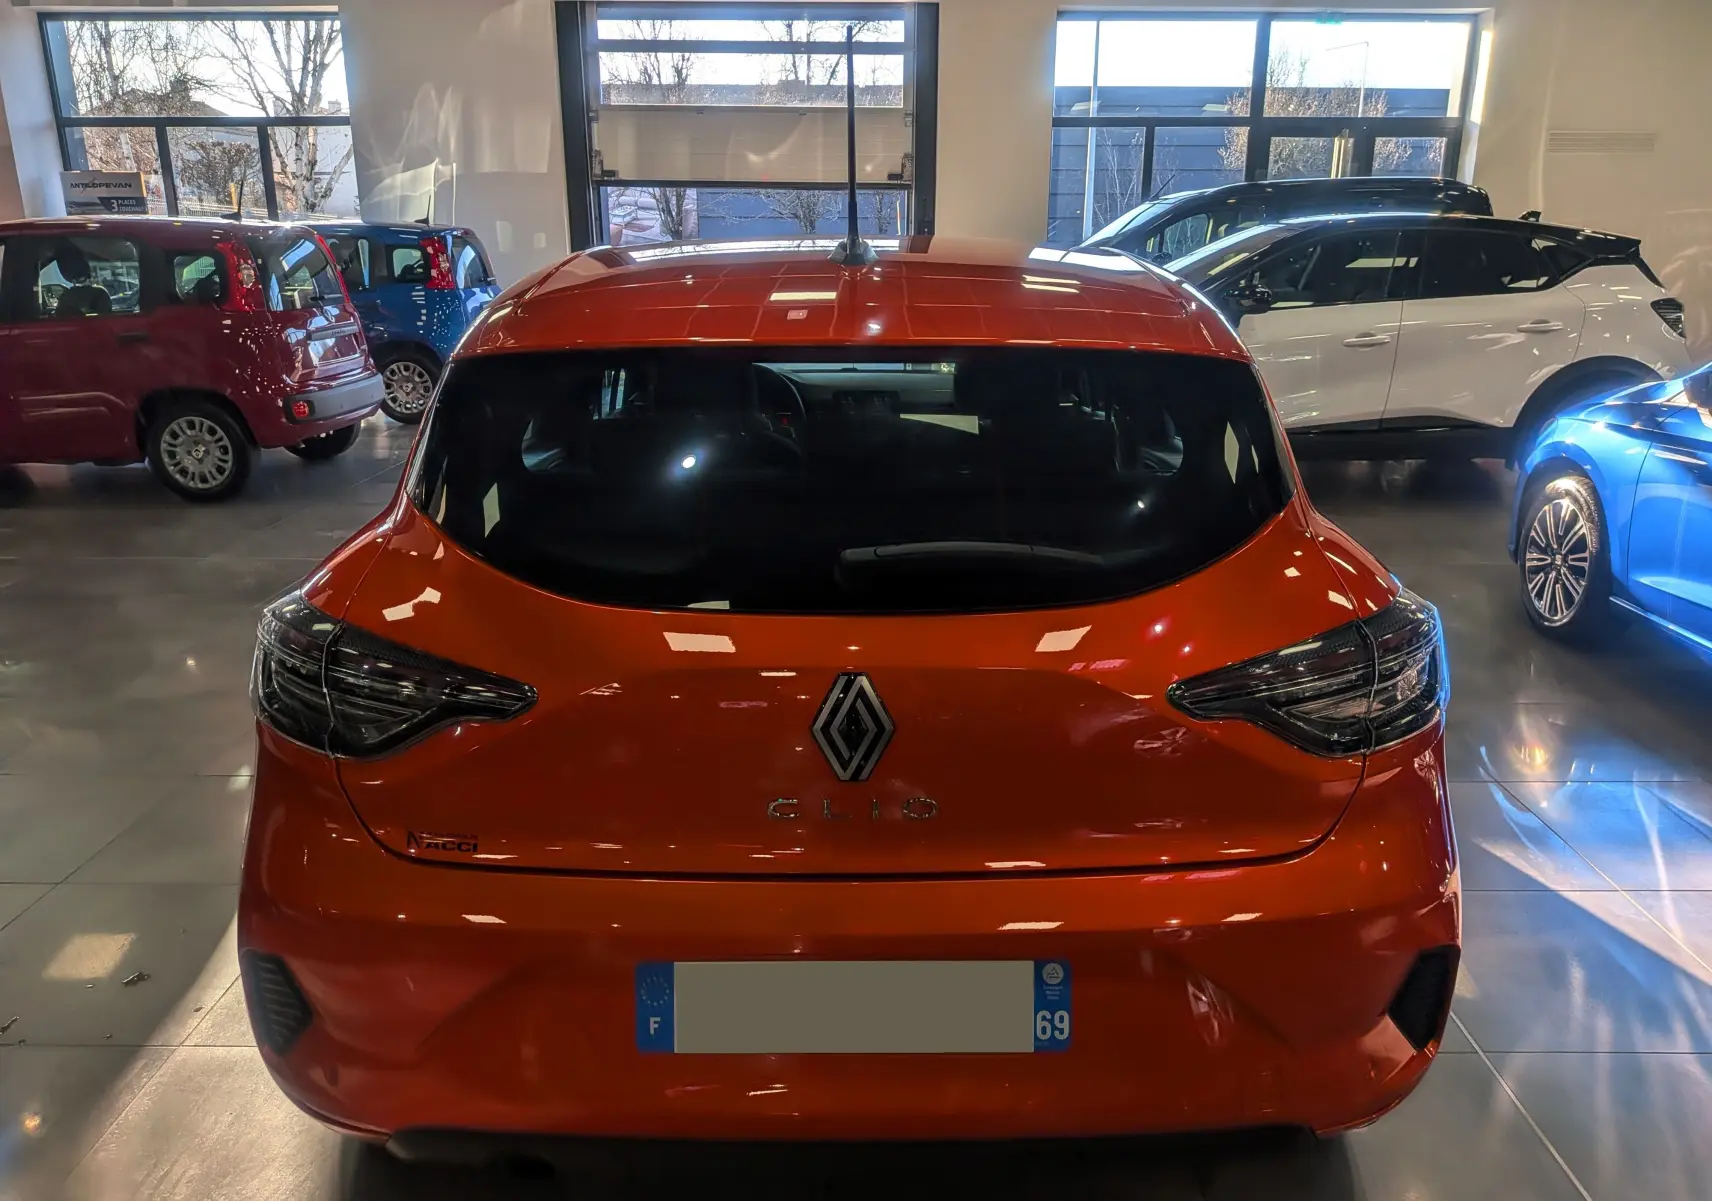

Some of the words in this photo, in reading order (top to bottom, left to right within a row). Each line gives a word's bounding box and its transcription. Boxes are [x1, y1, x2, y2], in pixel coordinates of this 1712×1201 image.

[110, 199, 118, 212] 3
[767, 798, 938, 819] CLIO
[649, 1016, 661, 1036] F
[1036, 1010, 1070, 1040] 69
